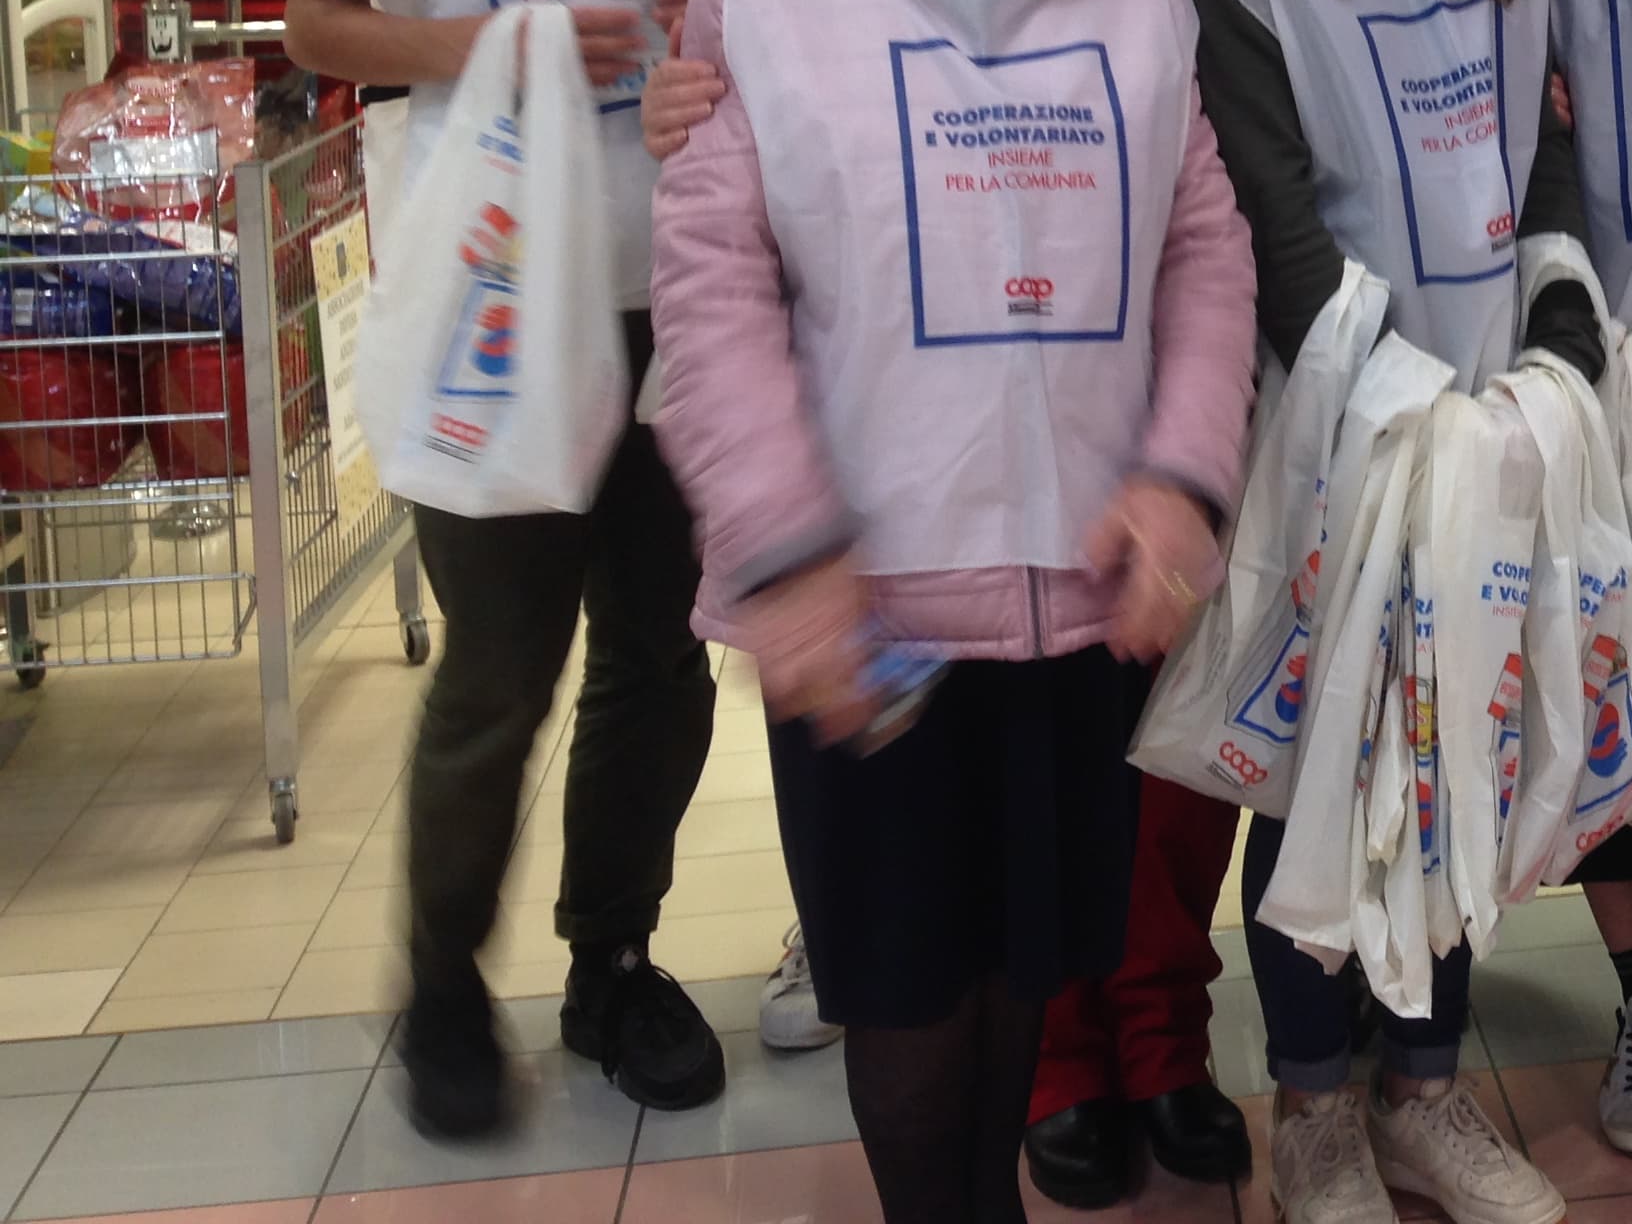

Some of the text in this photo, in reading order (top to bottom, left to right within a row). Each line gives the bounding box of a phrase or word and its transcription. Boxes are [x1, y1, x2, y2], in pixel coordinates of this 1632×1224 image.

[932, 104, 1094, 128] COOPERAZIONE
[926, 126, 1106, 148] E VOLONTARIATO
[1421, 135, 1441, 153] PER
[987, 147, 1054, 169] INSIEME
[945, 173, 976, 192] PER
[980, 172, 1002, 192] LA
[1004, 276, 1054, 302] coop
